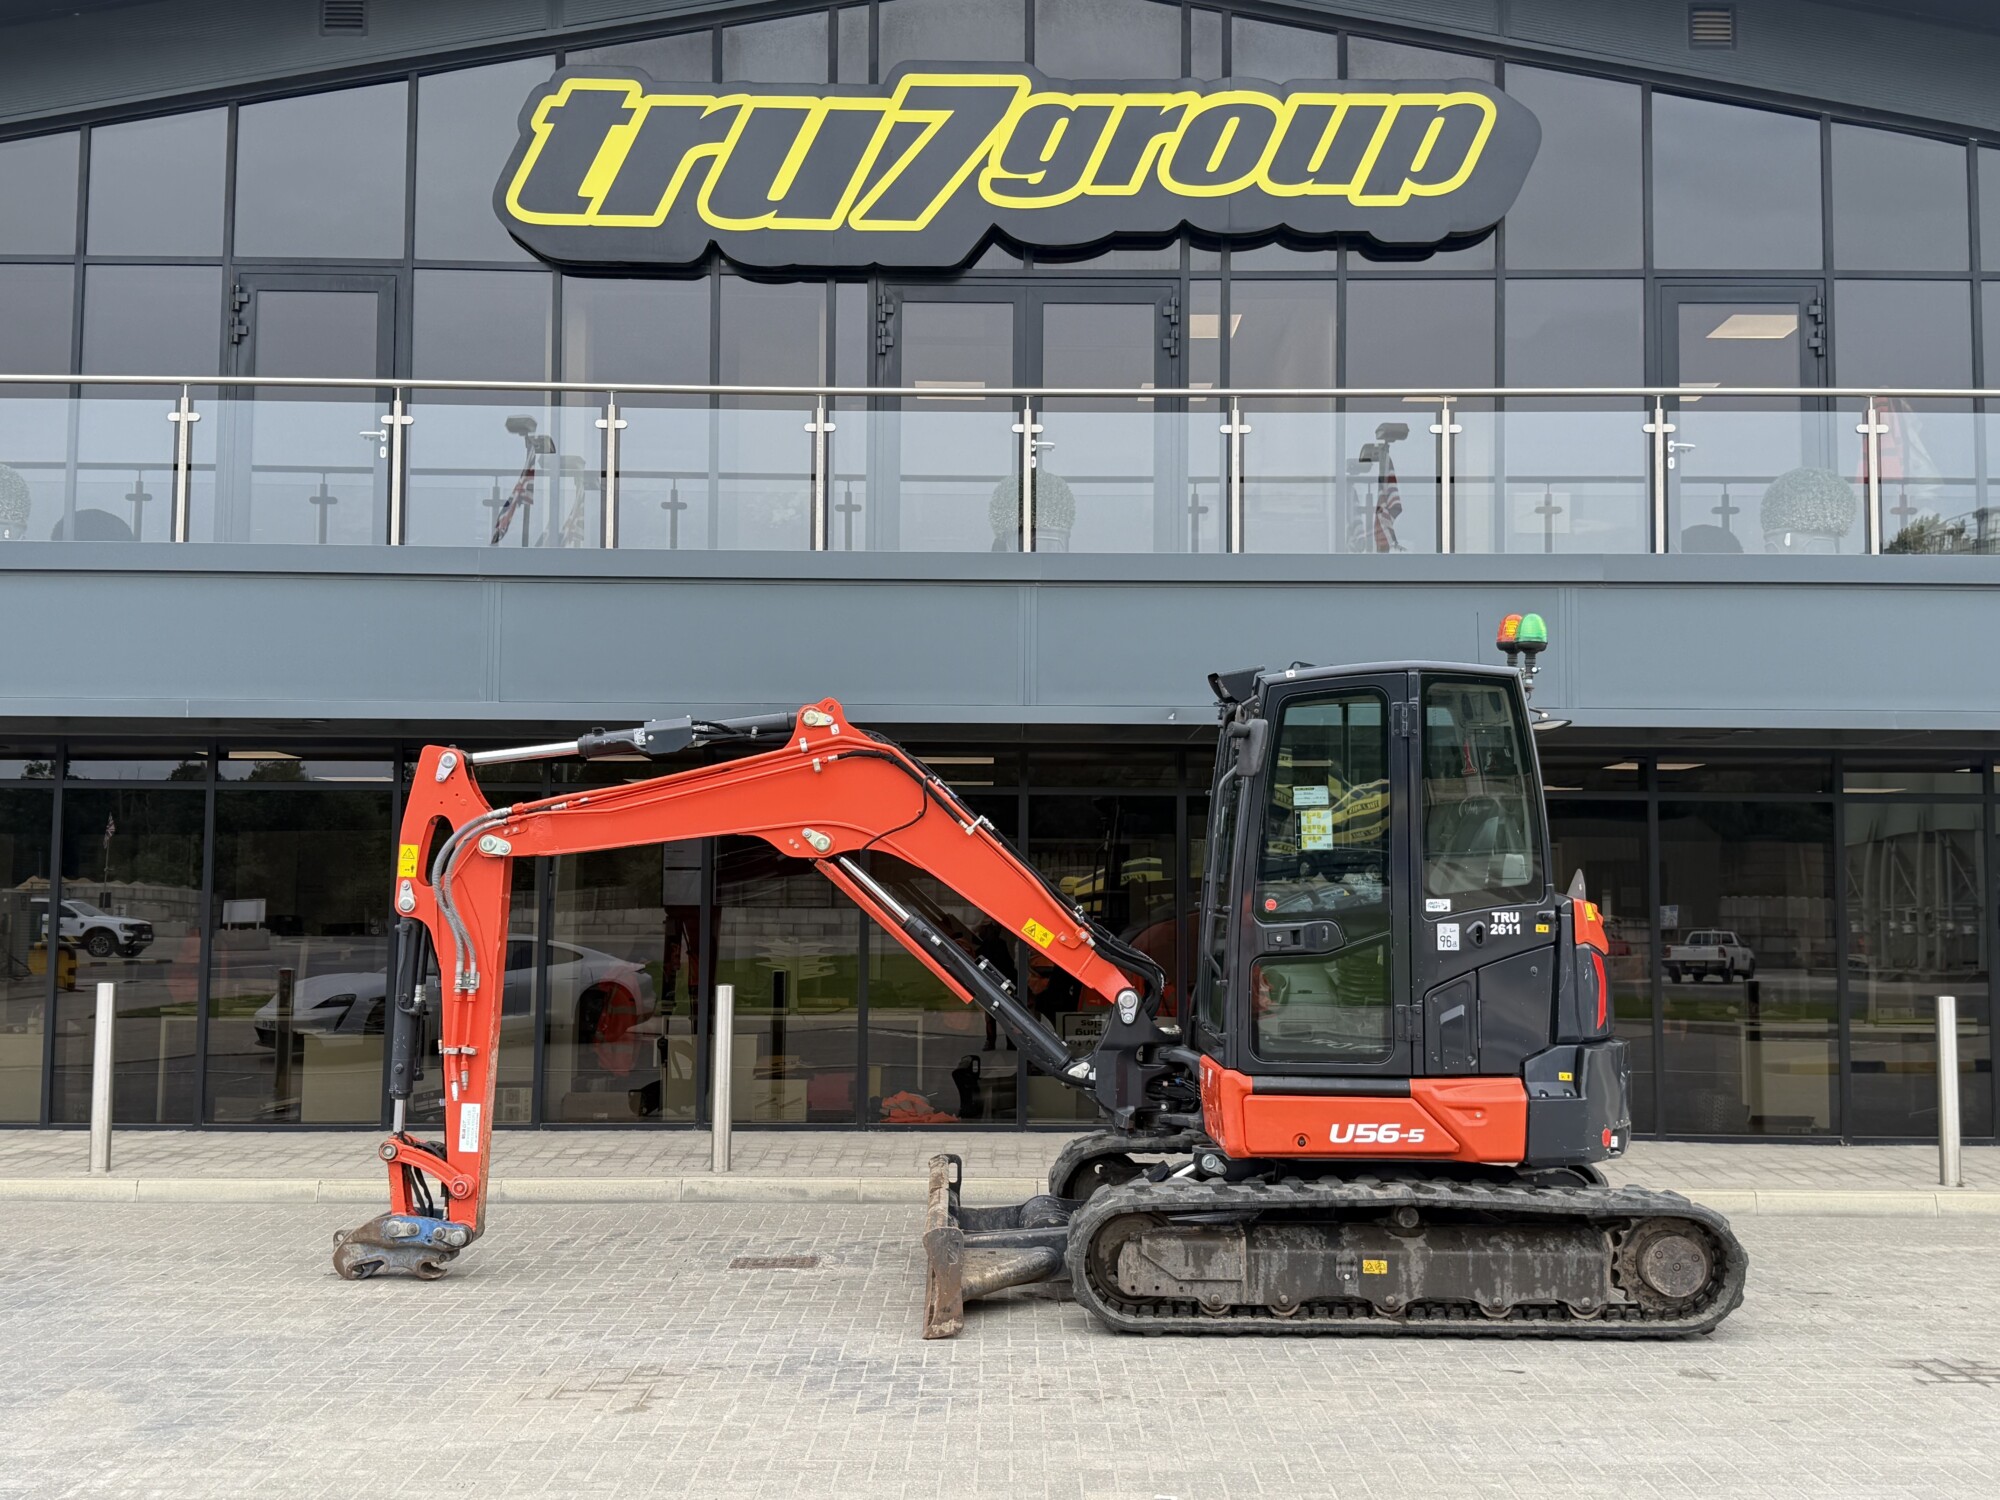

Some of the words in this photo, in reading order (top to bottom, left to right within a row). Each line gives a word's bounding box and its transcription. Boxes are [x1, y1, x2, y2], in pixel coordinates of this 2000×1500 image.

[1491, 911, 1520, 923] TRU
[1489, 923, 1521, 935] 2611
[1440, 935, 1452, 948] 96
[1329, 1123, 1426, 1144] U56-5
